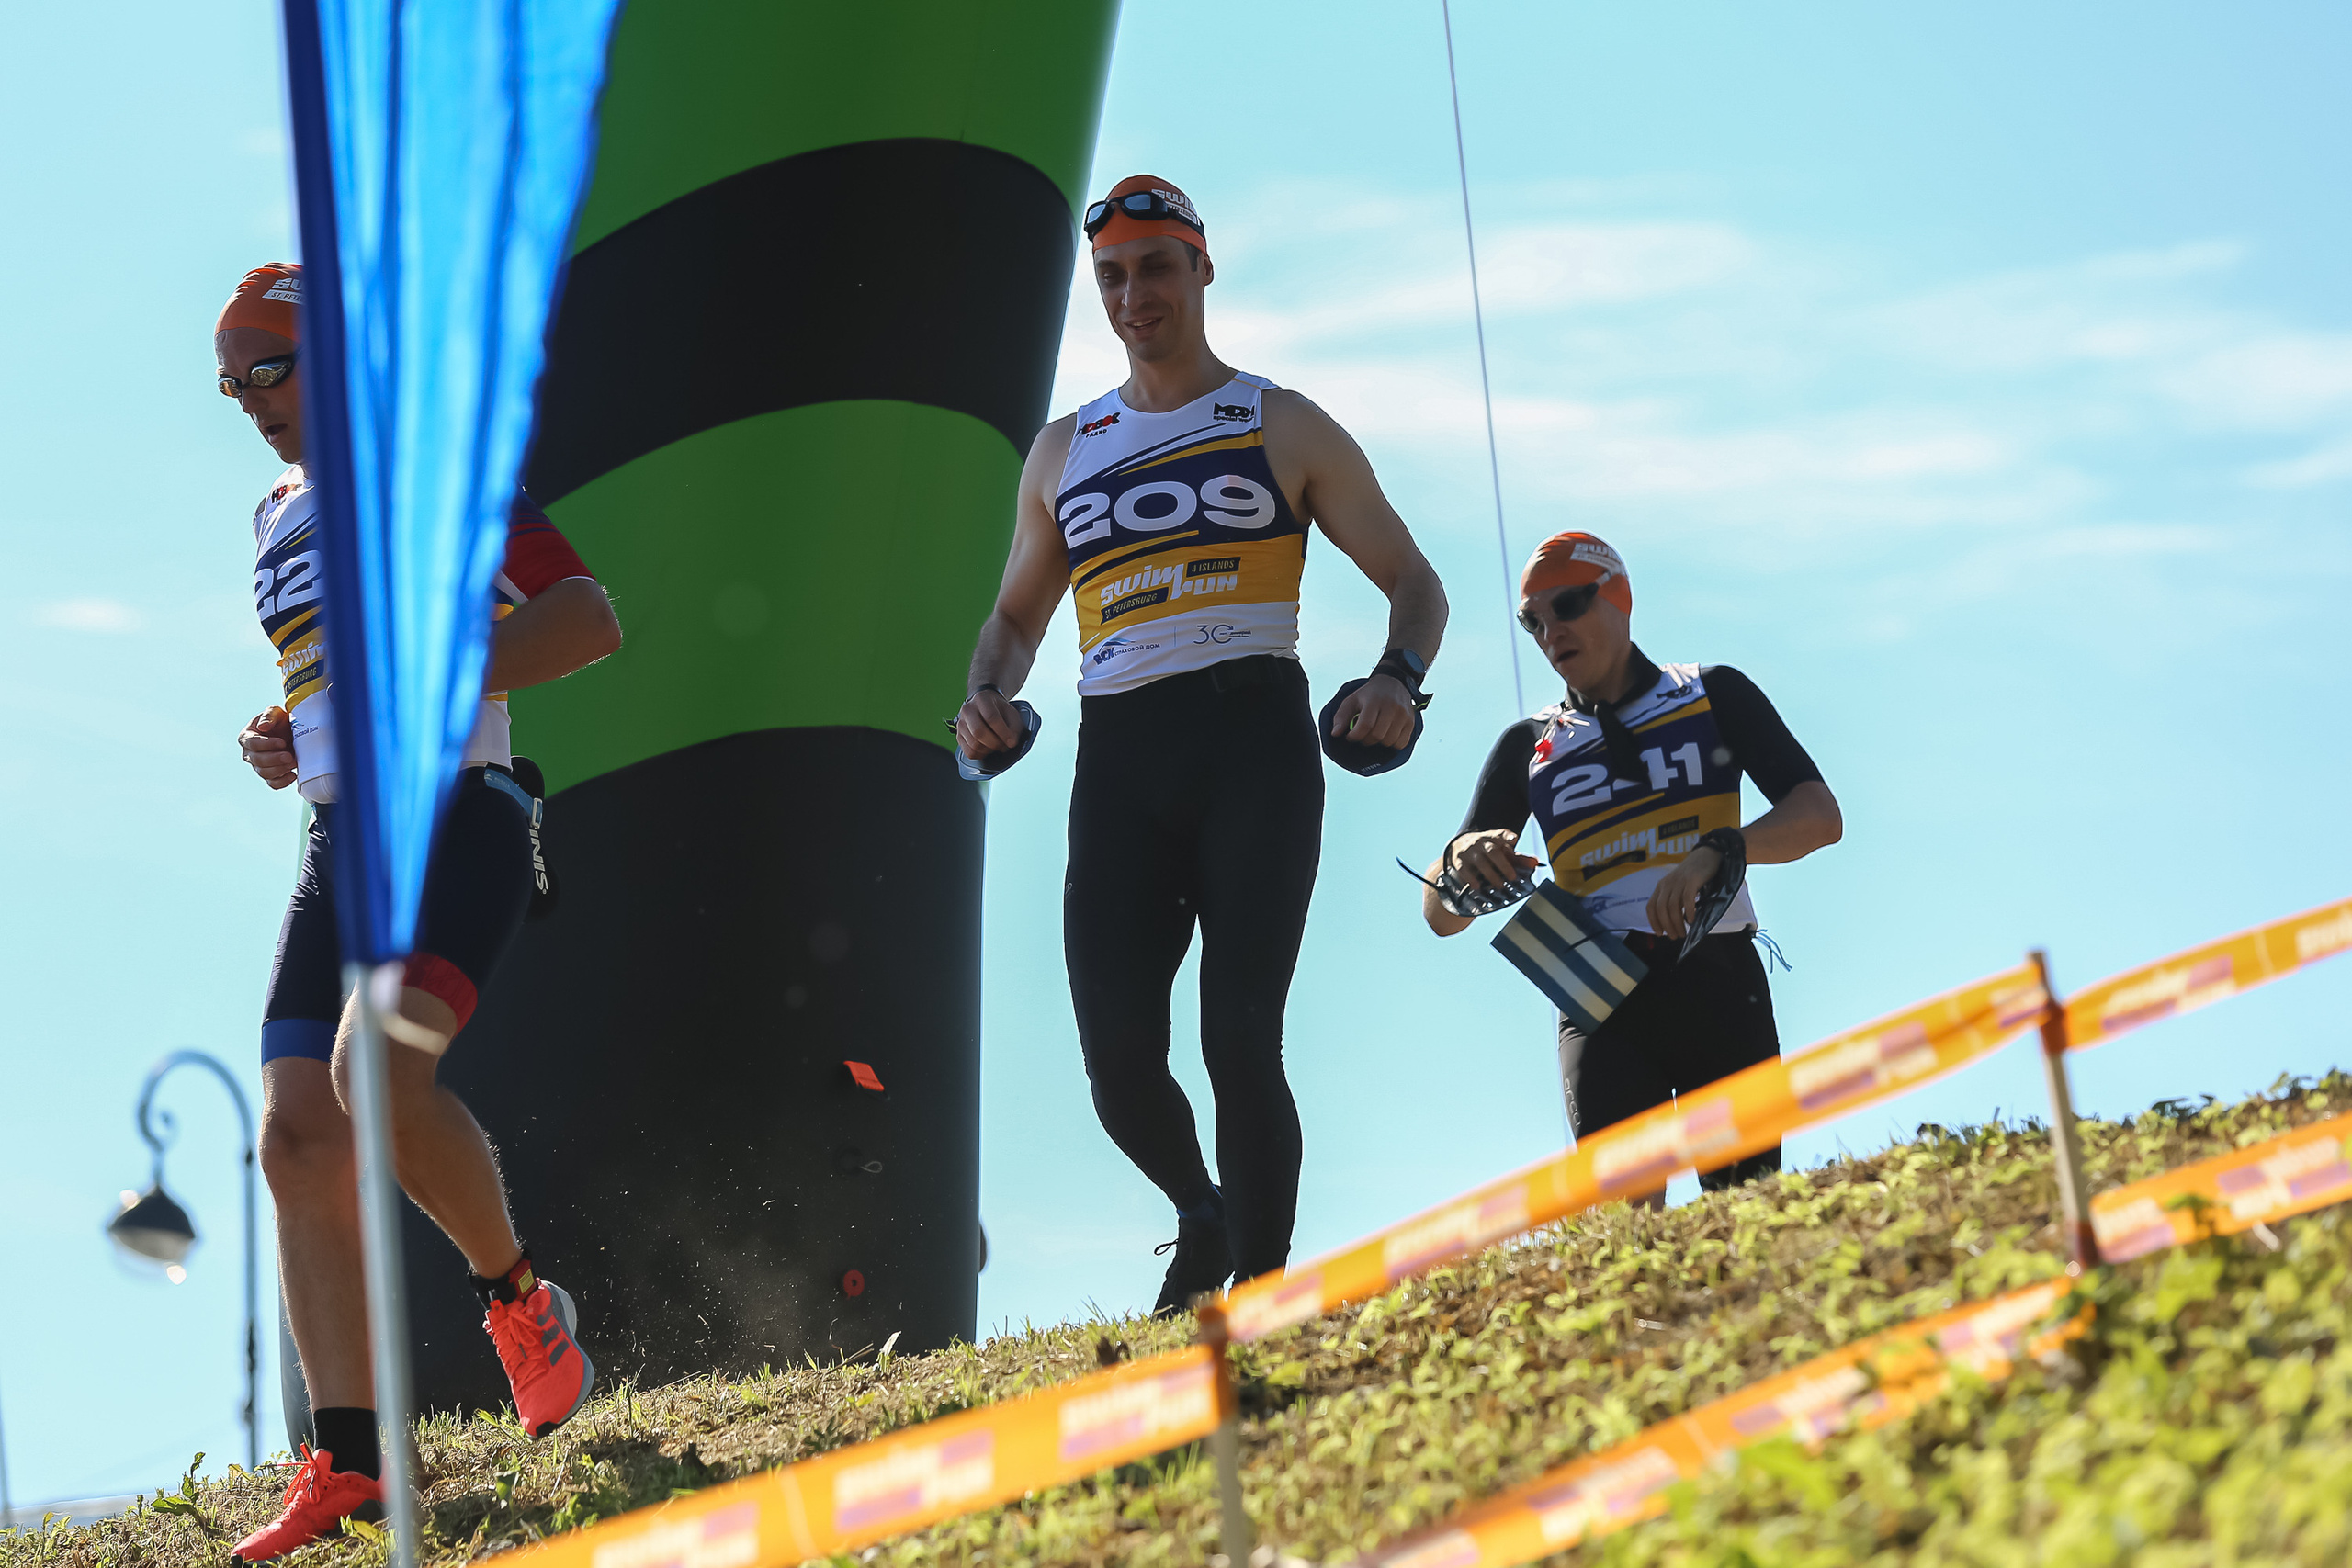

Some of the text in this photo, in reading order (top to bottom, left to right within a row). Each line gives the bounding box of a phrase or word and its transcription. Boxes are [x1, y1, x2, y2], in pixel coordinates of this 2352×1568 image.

[1058, 474, 1276, 550] 209
[254, 549, 323, 622] 22
[1198, 560, 1236, 572] ISLANDS
[1113, 593, 1159, 615] PETERSBURG
[529, 829, 548, 890] INIS
